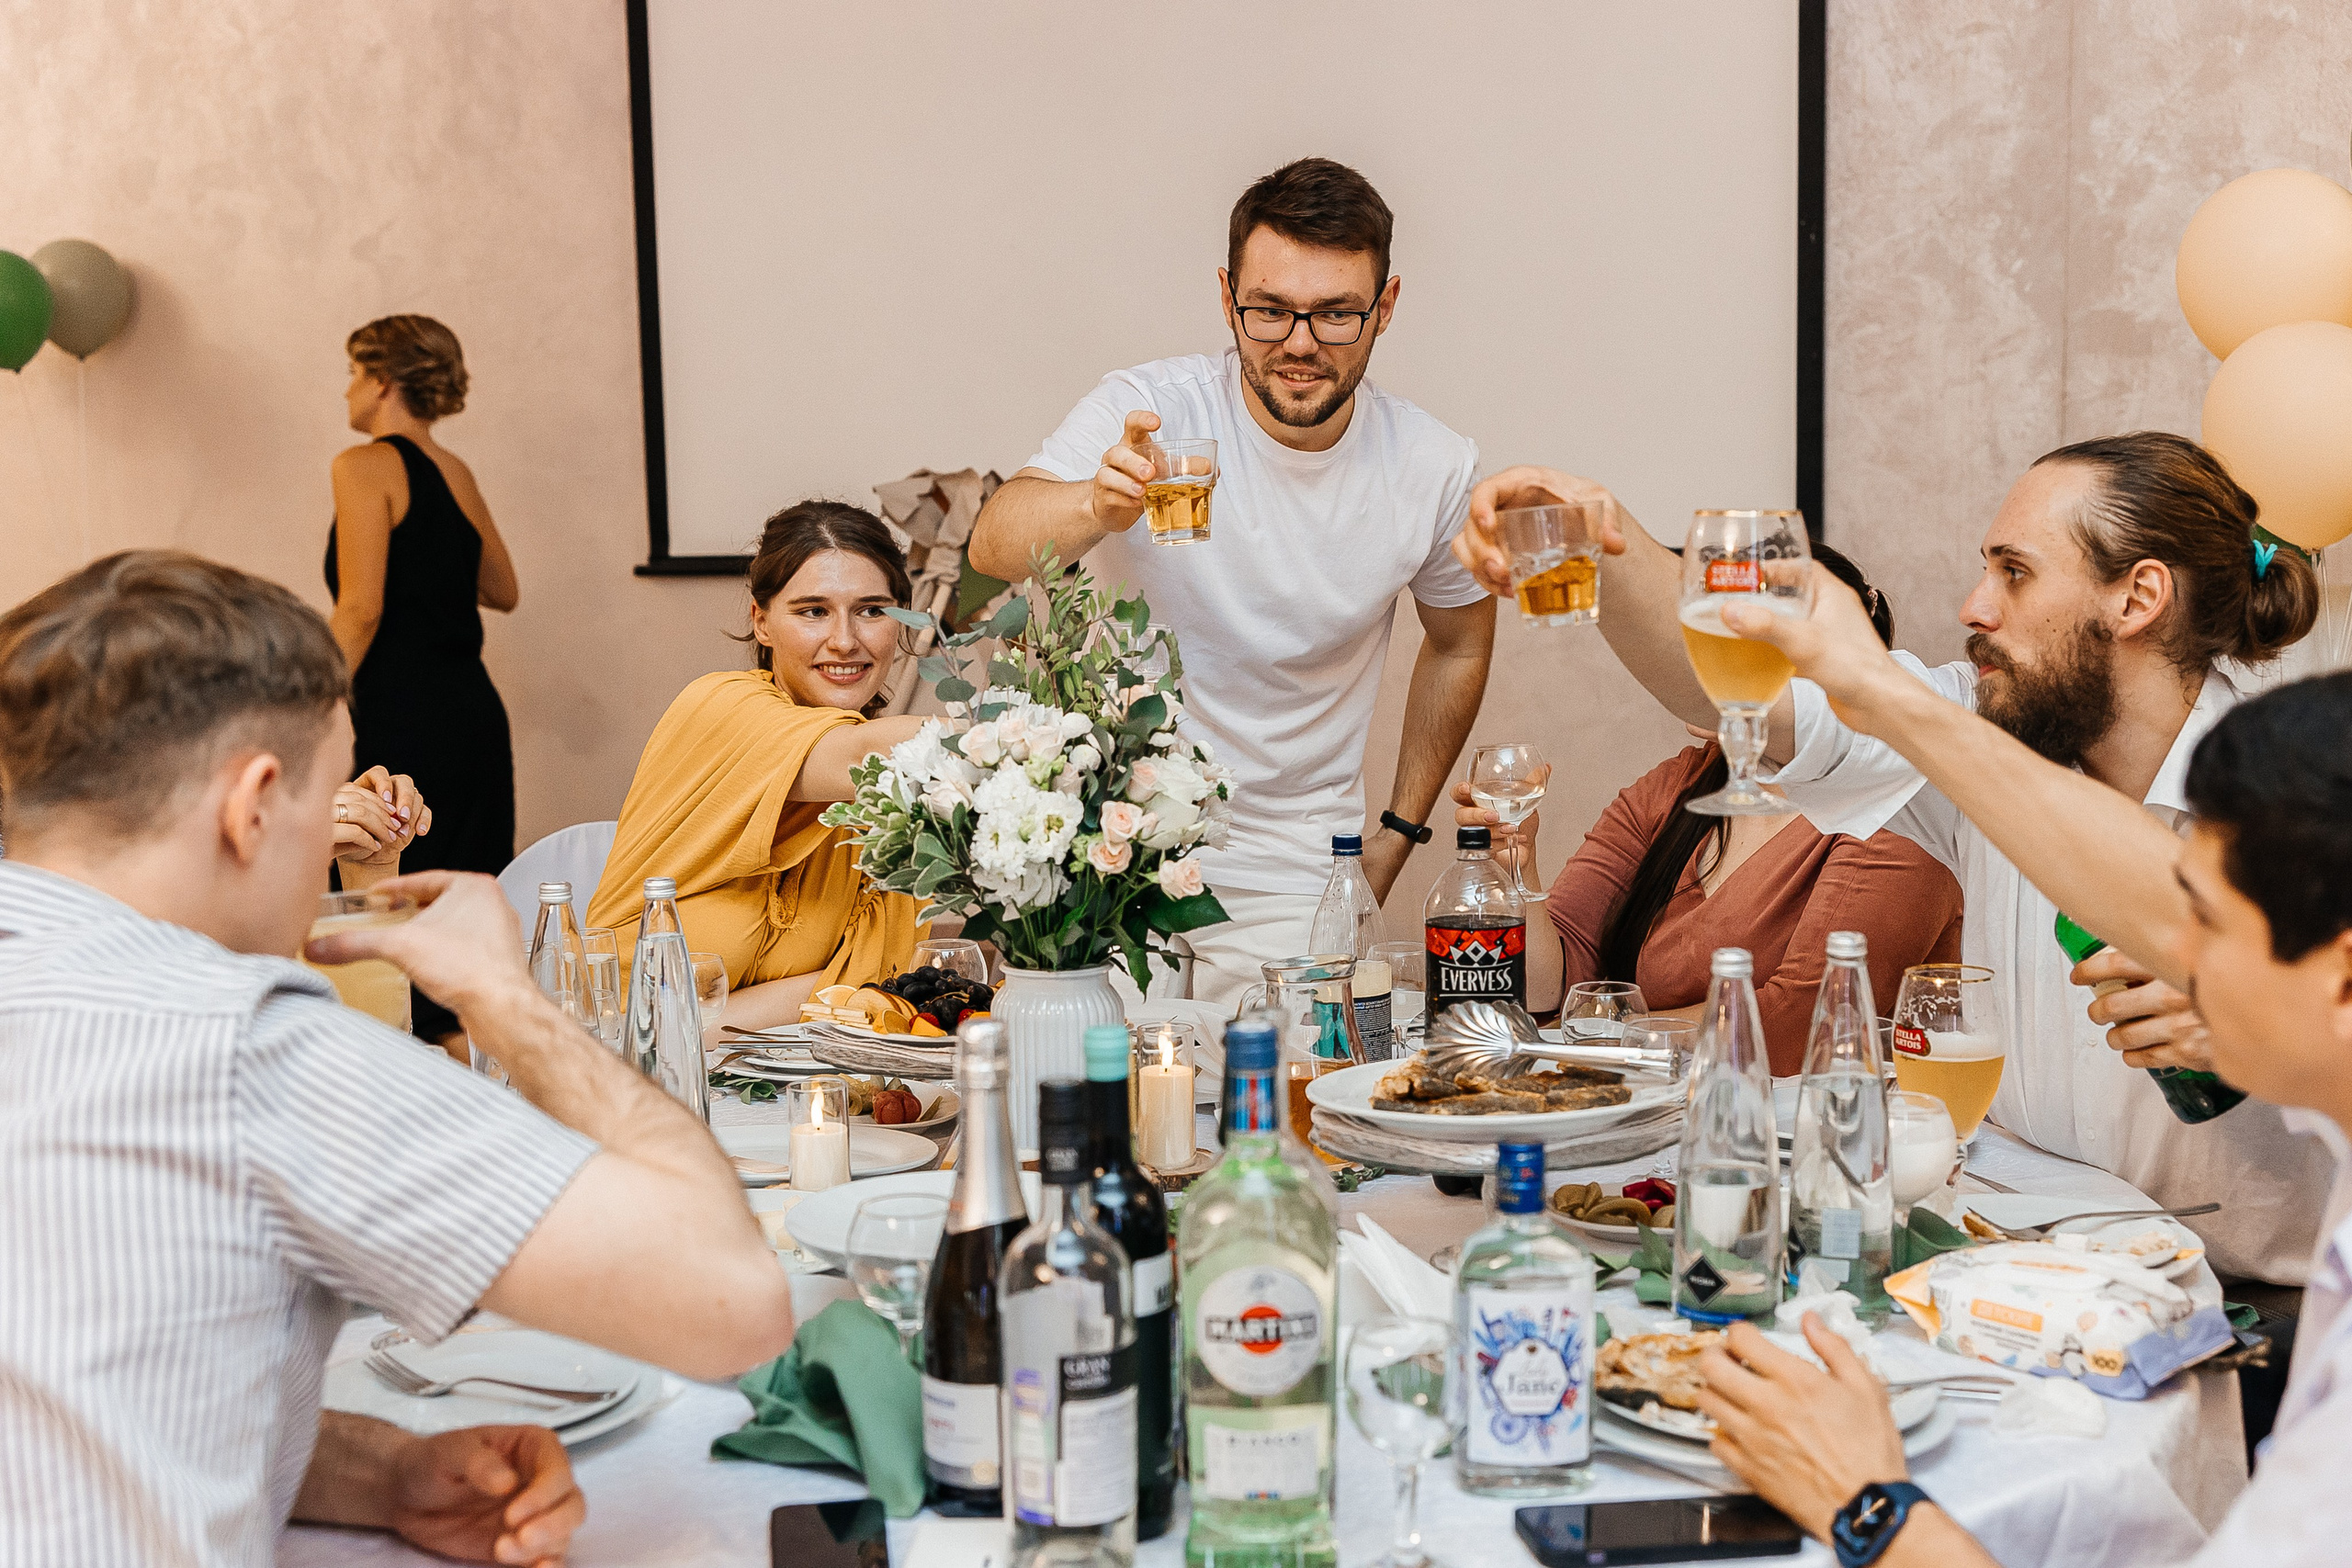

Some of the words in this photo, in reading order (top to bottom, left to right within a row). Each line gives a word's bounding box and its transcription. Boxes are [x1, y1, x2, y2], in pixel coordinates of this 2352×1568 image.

[1441, 966, 1512, 991] EVERVESS
[1895, 1029, 1922, 1042] STELLA
[1895, 1037, 1921, 1049] ARTOIS
[1205, 1315, 1316, 1342] MARTINI
